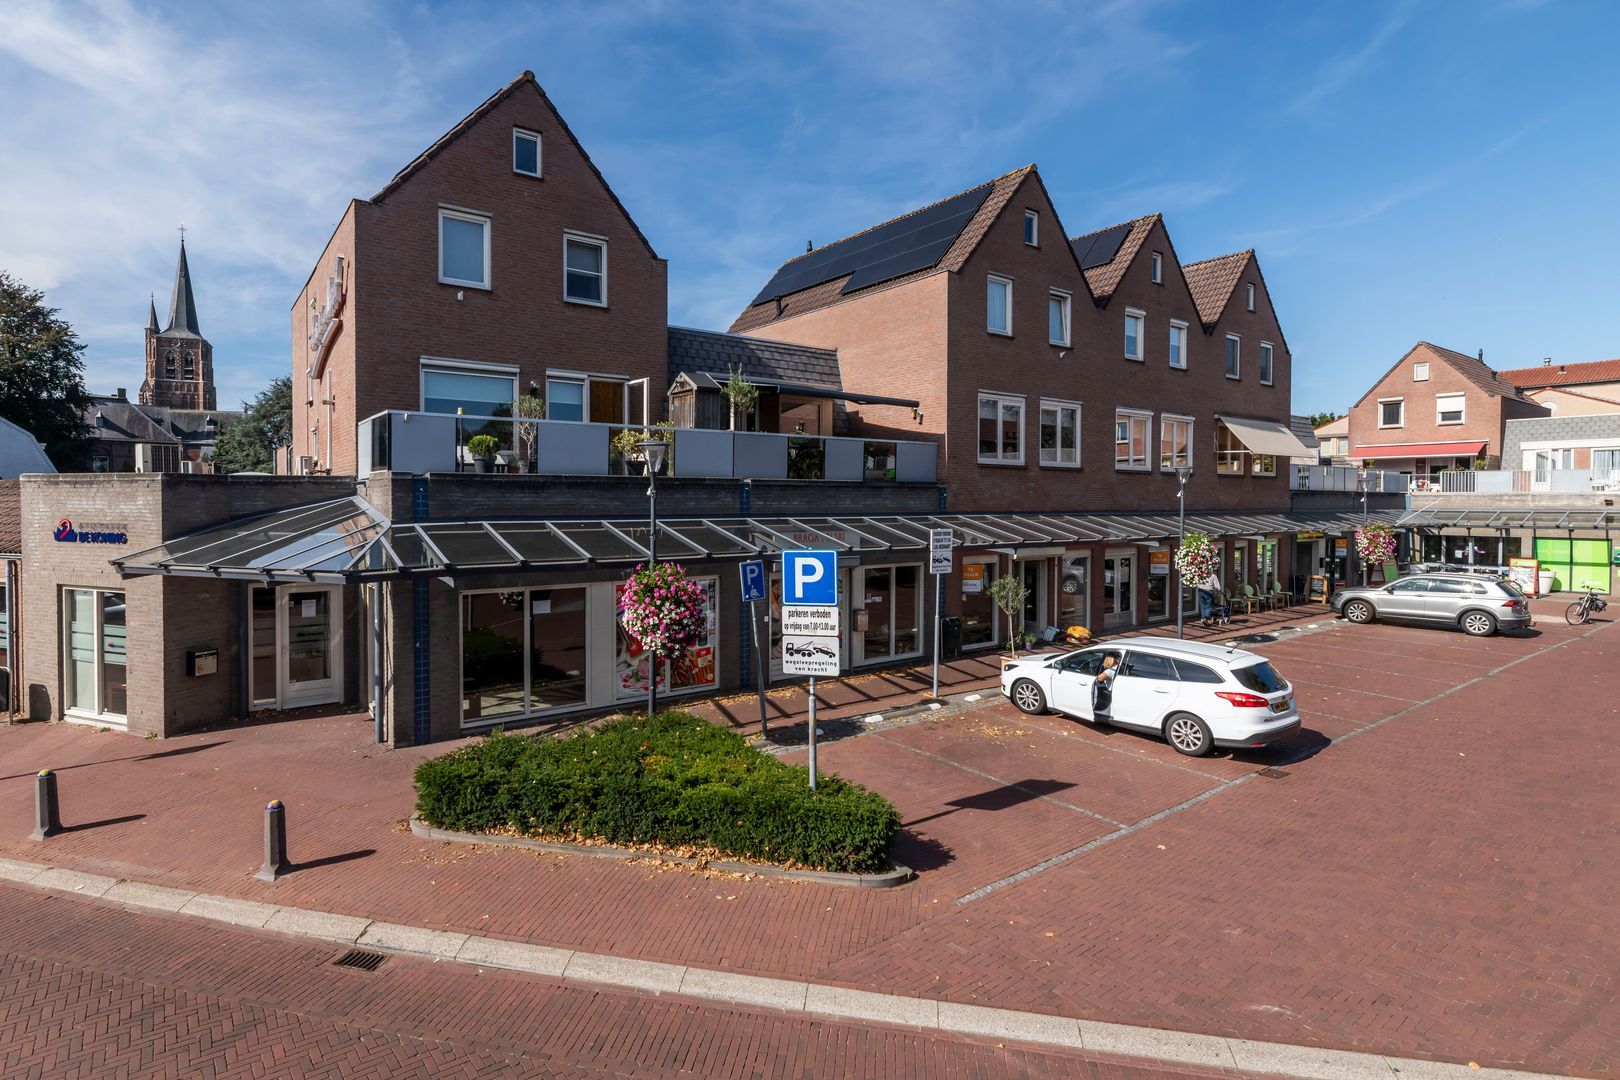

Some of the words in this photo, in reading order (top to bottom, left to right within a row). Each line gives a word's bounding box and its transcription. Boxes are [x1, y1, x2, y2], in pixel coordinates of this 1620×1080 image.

[746, 565, 759, 585] P
[795, 557, 824, 598] P
[788, 608, 809, 620] parkeren
[810, 609, 831, 618] verboden
[784, 623, 789, 631] op
[789, 622, 803, 632] vrijdag
[810, 622, 829, 631] 7.00-13.00
[785, 660, 837, 668] wegsleepregeling
